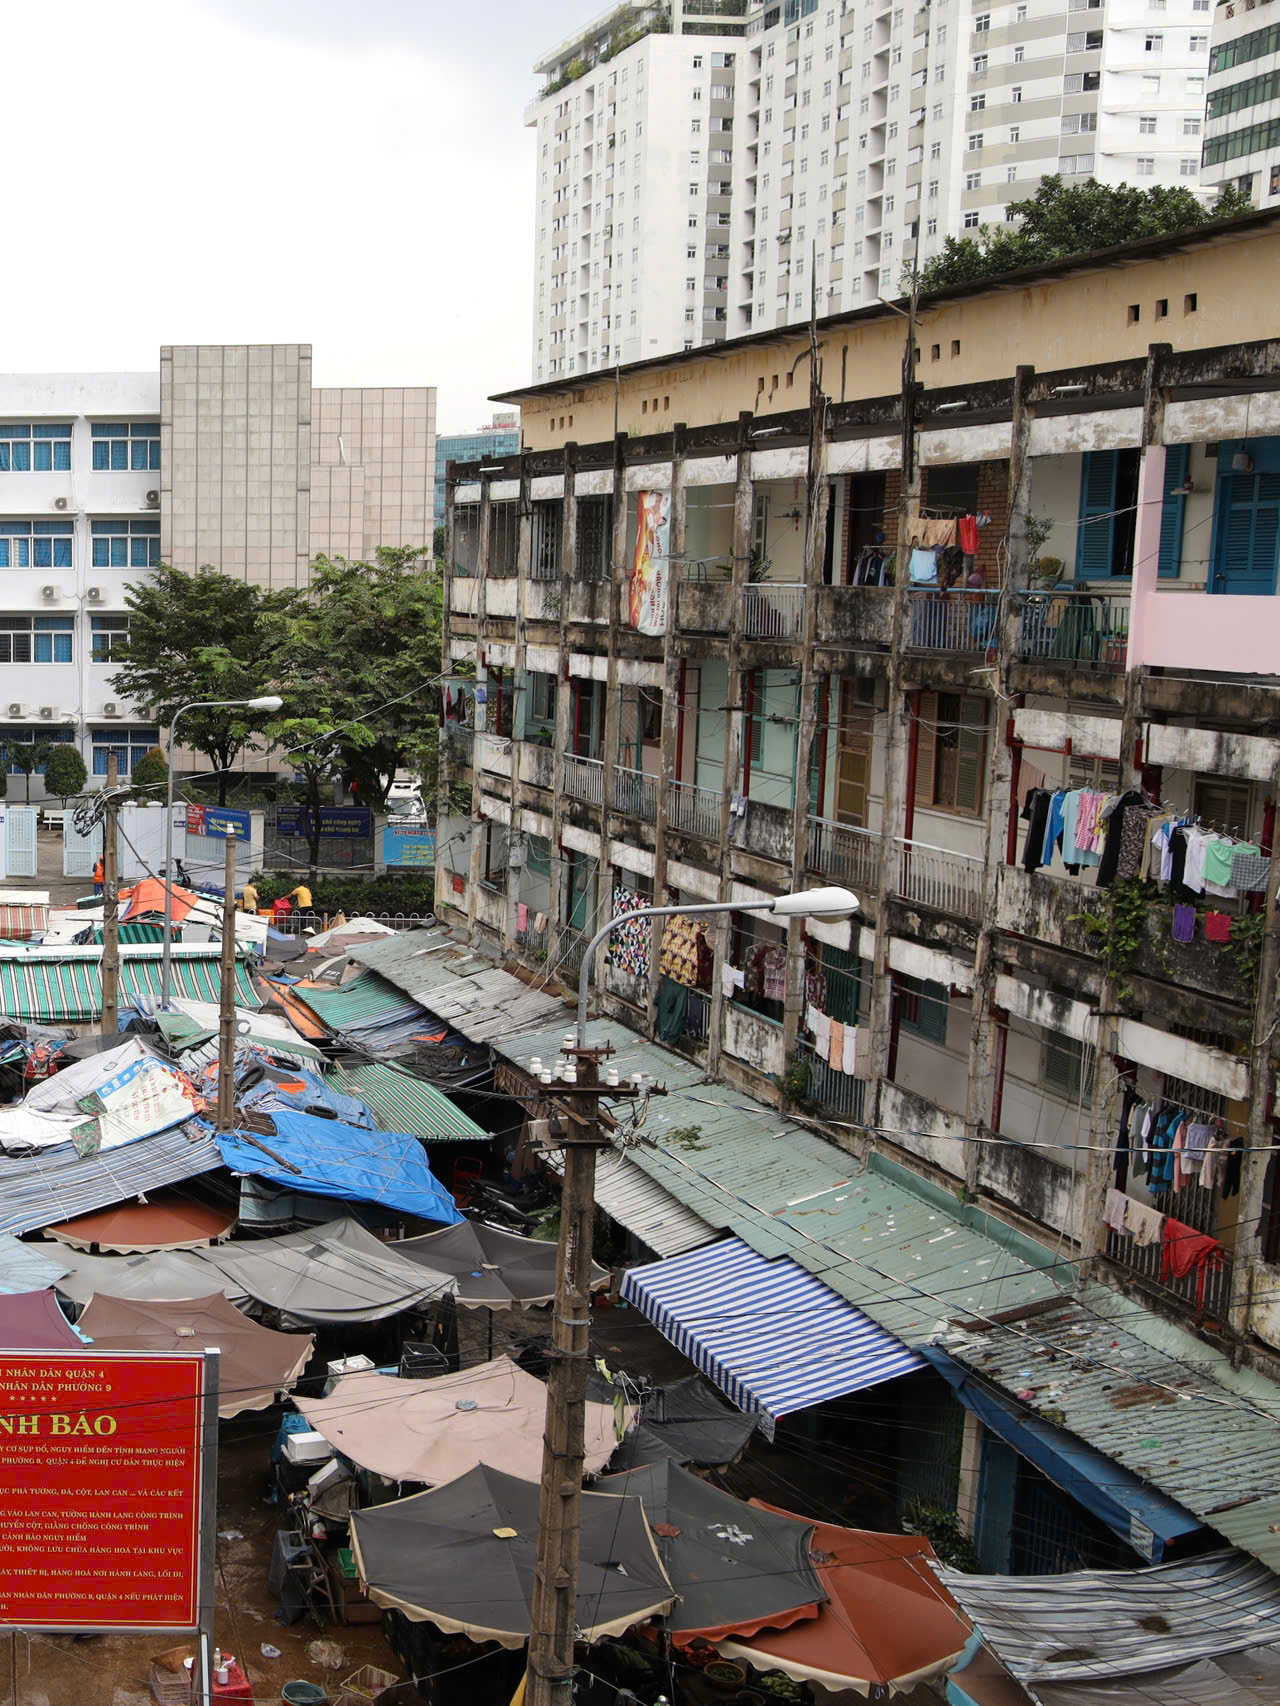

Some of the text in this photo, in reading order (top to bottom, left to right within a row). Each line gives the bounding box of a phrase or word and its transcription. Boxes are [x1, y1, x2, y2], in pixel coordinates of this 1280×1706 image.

[5, 1366, 36, 1377] NHÂN
[39, 1367, 61, 1377] DÂN
[64, 1367, 95, 1379] QUẬN
[98, 1370, 104, 1378] 4
[31, 1380, 53, 1391] DÂN
[57, 1382, 102, 1392] PHƯỜNG
[105, 1384, 112, 1392] 9
[48, 1407, 117, 1436] BÁO
